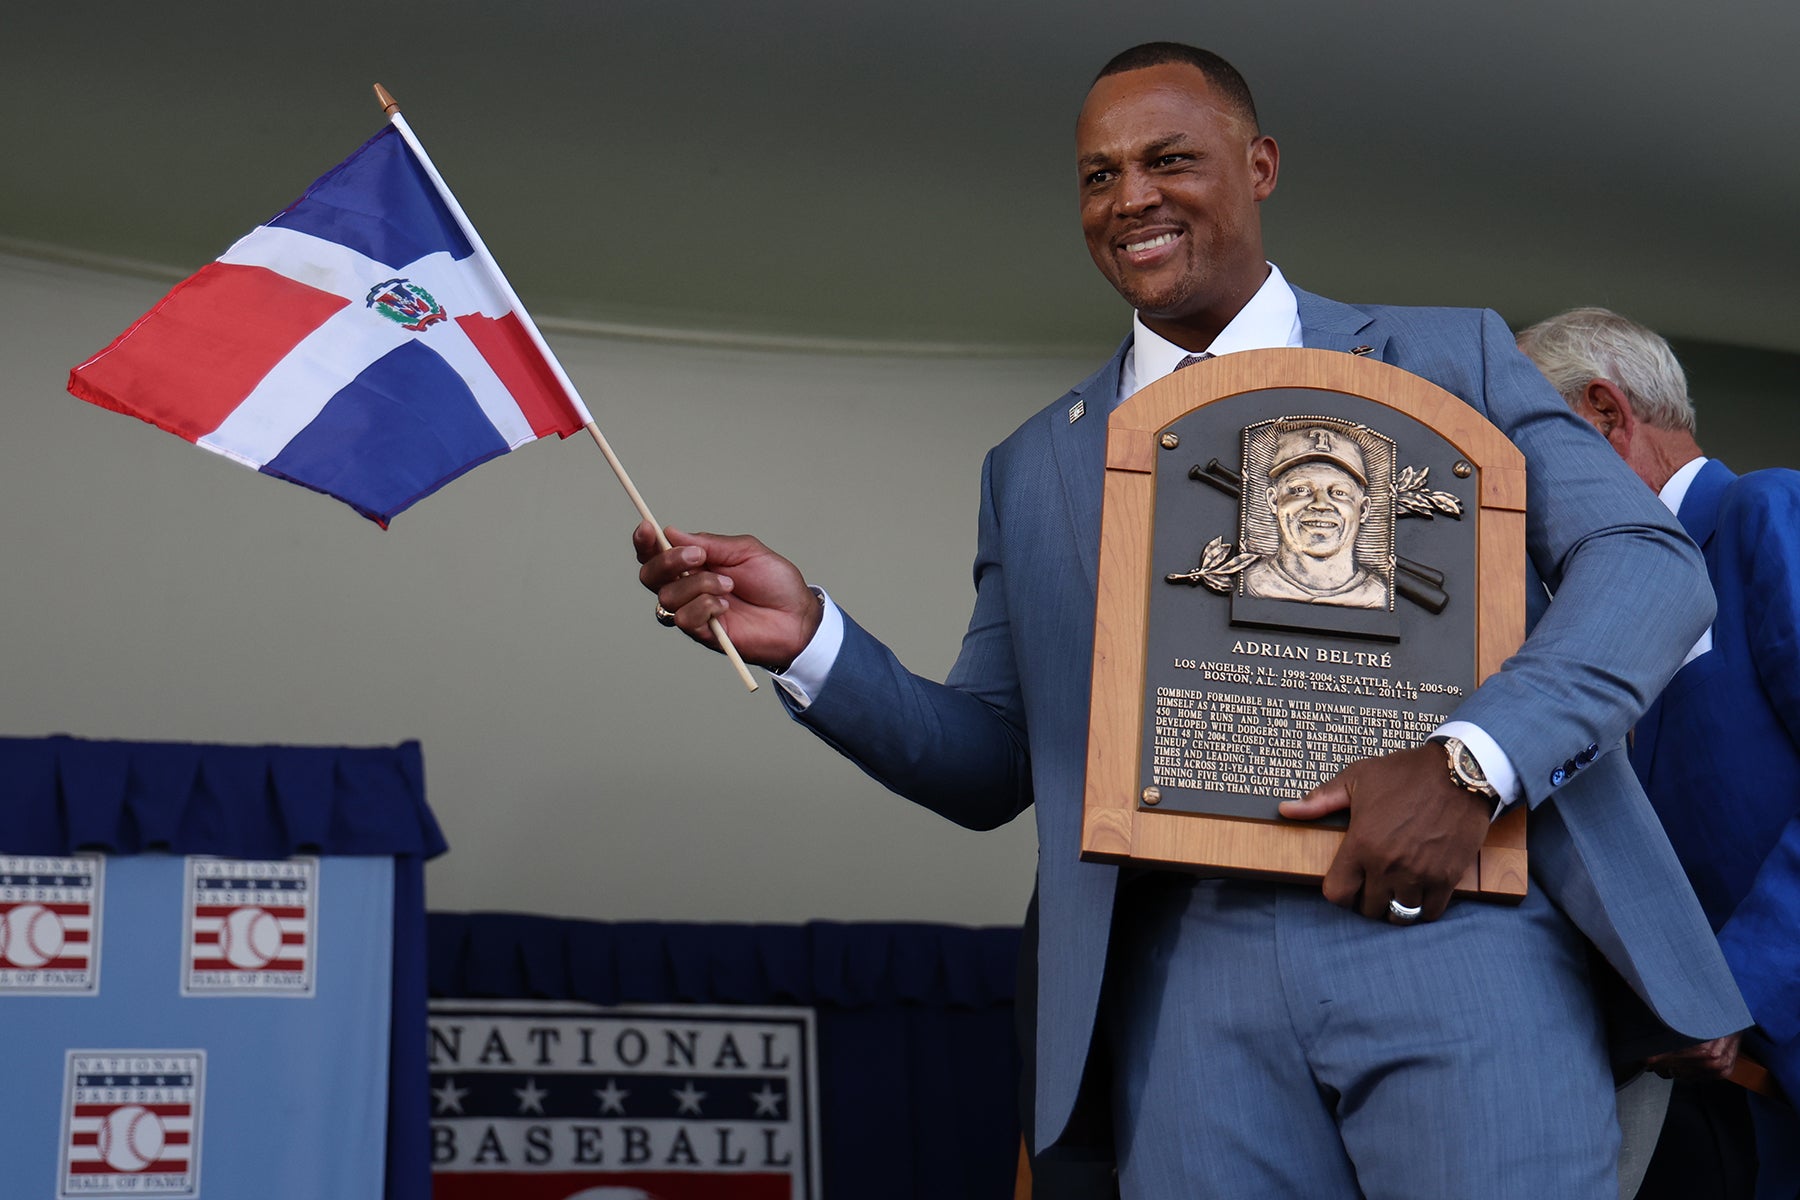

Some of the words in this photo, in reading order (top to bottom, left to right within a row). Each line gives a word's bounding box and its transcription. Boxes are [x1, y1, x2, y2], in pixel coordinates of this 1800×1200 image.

[1232, 640, 1309, 660] ADRIAN
[1316, 648, 1392, 668] BELTRÉ
[1174, 659, 1196, 669] LOS
[1200, 661, 1254, 675] ANGELES,
[1257, 667, 1278, 677] N.L.
[1283, 669, 1336, 682] 1998-2004;
[1339, 675, 1391, 689] SEATTLE,
[1395, 680, 1417, 691] A.L.
[1420, 682, 1463, 696] 2005-09;
[1204, 671, 1253, 685] BOSTON,
[1256, 676, 1277, 687] A.L.
[1280, 678, 1307, 690] 2010;
[1311, 681, 1351, 694] TEXAS,
[1354, 686, 1375, 696] A.L.
[1379, 688, 1418, 700] 2011-18
[1157, 687, 1202, 700] COMBINED
[1207, 692, 1262, 705] FORMIDABLE
[1267, 698, 1284, 708] BAT
[1288, 700, 1310, 710] WITH
[1315, 702, 1356, 715] DYNAMIC
[1360, 707, 1398, 719] DEFENSE
[1402, 711, 1414, 720] TO
[1157, 697, 1194, 709] HIMSELF
[1197, 701, 1208, 710] AS
[1211, 703, 1216, 711] A
[1220, 703, 1258, 715] PREMIER
[1260, 707, 1288, 718] THIRD
[1291, 710, 1331, 722] BASEMAN
[1342, 715, 1359, 725] THE
[1363, 716, 1386, 727] FIRST
[1390, 720, 1401, 729] TO
[1156, 707, 1171, 717] 450
[1178, 709, 1202, 720] HOME
[1210, 712, 1234, 723] RUNS
[1241, 715, 1260, 725] AND
[1267, 718, 1288, 728] 3,000
[1296, 721, 1318, 731] HITS.
[1326, 723, 1374, 736] DOMINICAN
[1382, 729, 1425, 741] REPUBLIC
[1156, 717, 1207, 730] DEVELOPED
[1211, 722, 1234, 733] WITH
[1238, 725, 1278, 736] DODGERS
[1282, 729, 1302, 739] INTO
[1307, 731, 1357, 744] BASEBALL'S
[1361, 736, 1378, 746] TOP
[1382, 739, 1406, 749] HOME
[1155, 726, 1178, 737] WITH
[1181, 729, 1191, 738] 48
[1194, 731, 1204, 739] IN
[1208, 732, 1228, 742] 2004.
[1232, 734, 1265, 745] CLOSED
[1269, 738, 1302, 749] CAREER
[1306, 741, 1328, 752] WITH
[1332, 744, 1384, 756] EIGHT-YEAR
[1155, 736, 1187, 748] LINEUP
[1192, 740, 1254, 755] CENTERPIECE,
[1260, 747, 1304, 759] REACHING
[1309, 751, 1326, 761] THE
[1154, 746, 1180, 757] TIMES
[1184, 750, 1202, 759] AND
[1206, 751, 1245, 763] LEADING
[1248, 755, 1265, 765] THE
[1269, 757, 1302, 769] MAJORS
[1306, 761, 1315, 770] IN
[1319, 763, 1339, 772] HITS
[1154, 756, 1181, 767] REELS
[1184, 760, 1216, 771] ACROSS
[1219, 763, 1254, 774] 21-YEAR
[1258, 766, 1291, 778] CAREER
[1295, 770, 1317, 780] WITH
[1153, 766, 1193, 778] WINNING
[1197, 770, 1217, 780] FIVE
[1222, 773, 1246, 783] GOLD
[1251, 776, 1279, 786] GLOVE
[1153, 776, 1175, 786] WITH
[1178, 779, 1202, 789] MORE
[1204, 781, 1224, 791] HITS
[1226, 783, 1250, 794] THAN
[1253, 786, 1271, 796] ANY
[1273, 787, 1302, 799] OTHER
[429, 1027, 789, 1069] NATIONAL
[430, 1126, 792, 1166] BASEBALL
